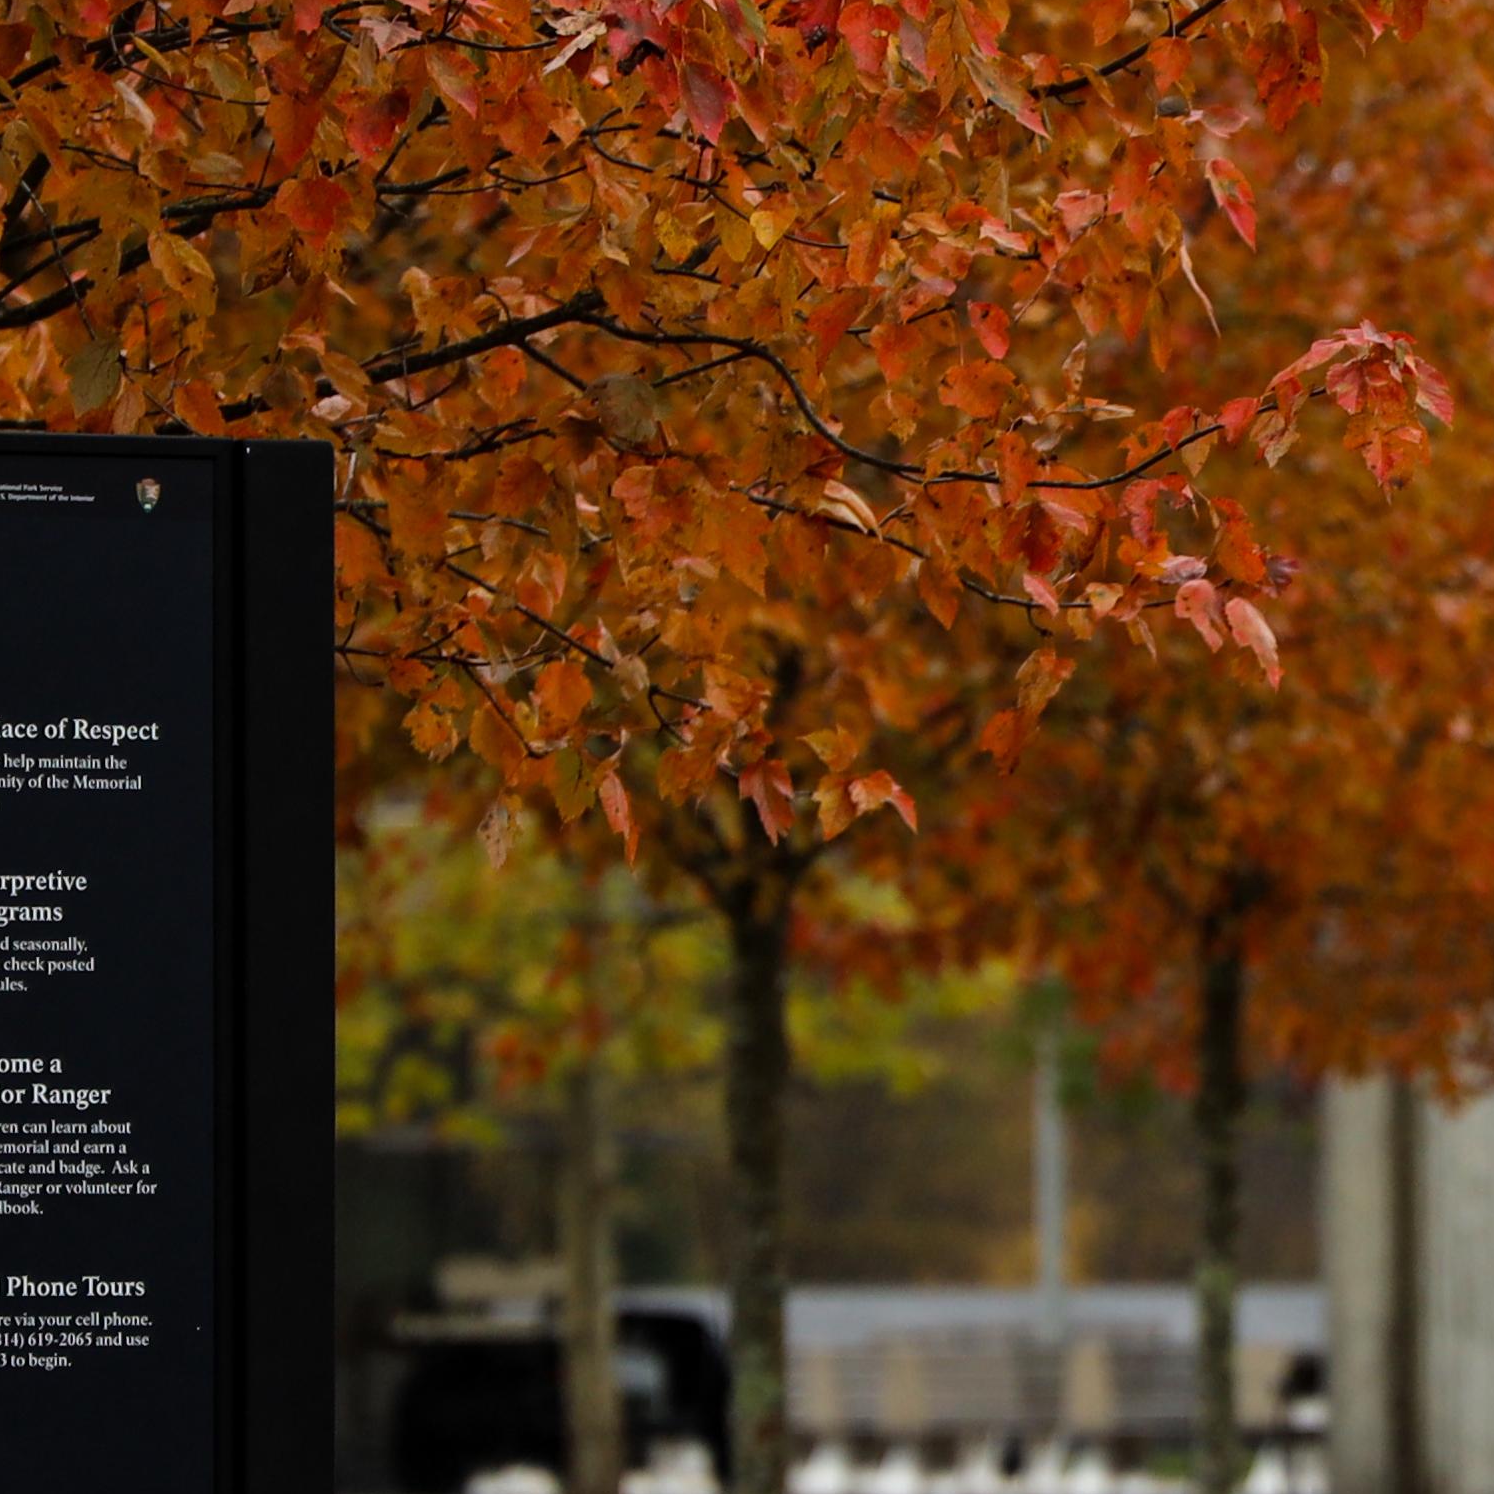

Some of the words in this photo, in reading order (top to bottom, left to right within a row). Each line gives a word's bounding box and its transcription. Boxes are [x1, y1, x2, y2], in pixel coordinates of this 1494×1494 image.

[44, 718, 69, 739] of
[73, 718, 159, 746] Respect
[3, 753, 35, 772] help
[38, 754, 101, 769] maintain
[105, 755, 127, 770] the
[28, 773, 45, 789] of
[47, 774, 69, 789] the
[73, 774, 142, 790] Memorial
[49, 1058, 62, 1073] a
[31, 1083, 111, 1110] Ranger
[6, 1275, 77, 1297] Phone
[81, 1275, 145, 1297] Tours
